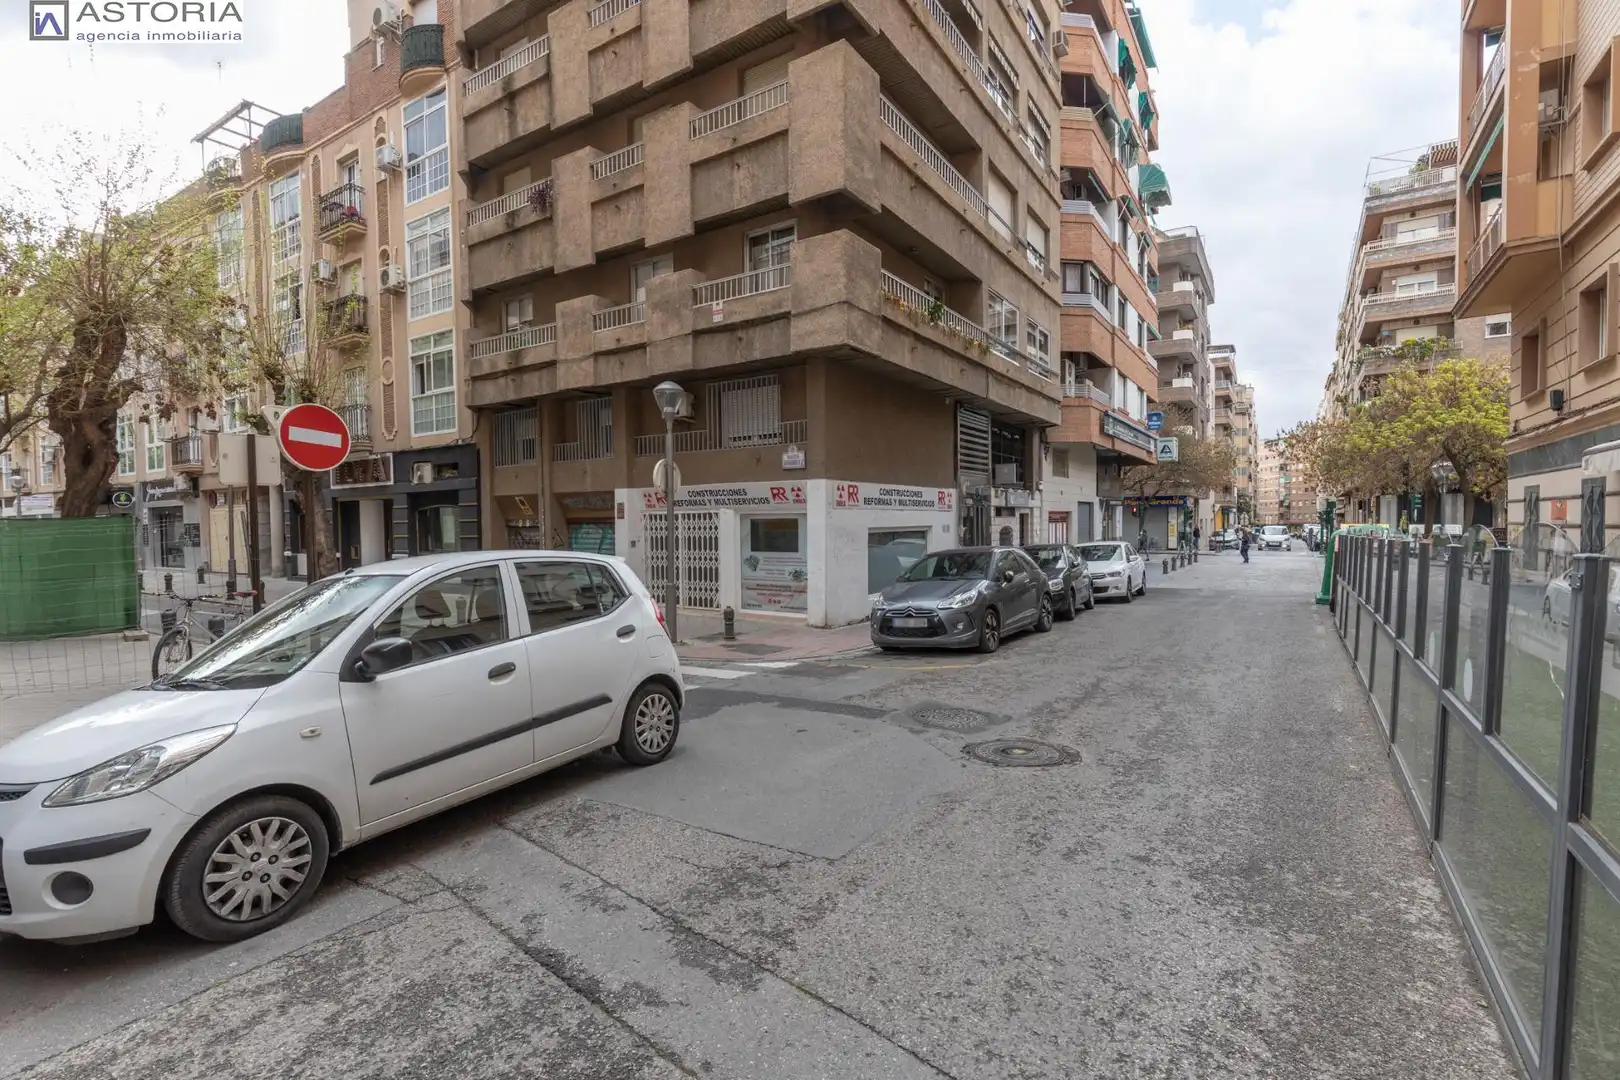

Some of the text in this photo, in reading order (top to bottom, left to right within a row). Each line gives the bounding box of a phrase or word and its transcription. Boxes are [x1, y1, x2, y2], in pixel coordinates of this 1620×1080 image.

[687, 488, 748, 498] CONSTRUCCIONES
[770, 487, 788, 501] RR
[879, 488, 923, 498] CONSTRUCCIONES
[673, 499, 707, 508] REFORMAS
[713, 496, 770, 506] MULTISERVICIOS
[863, 497, 935, 508] REFORMAS Y MULTISERVICIOS
